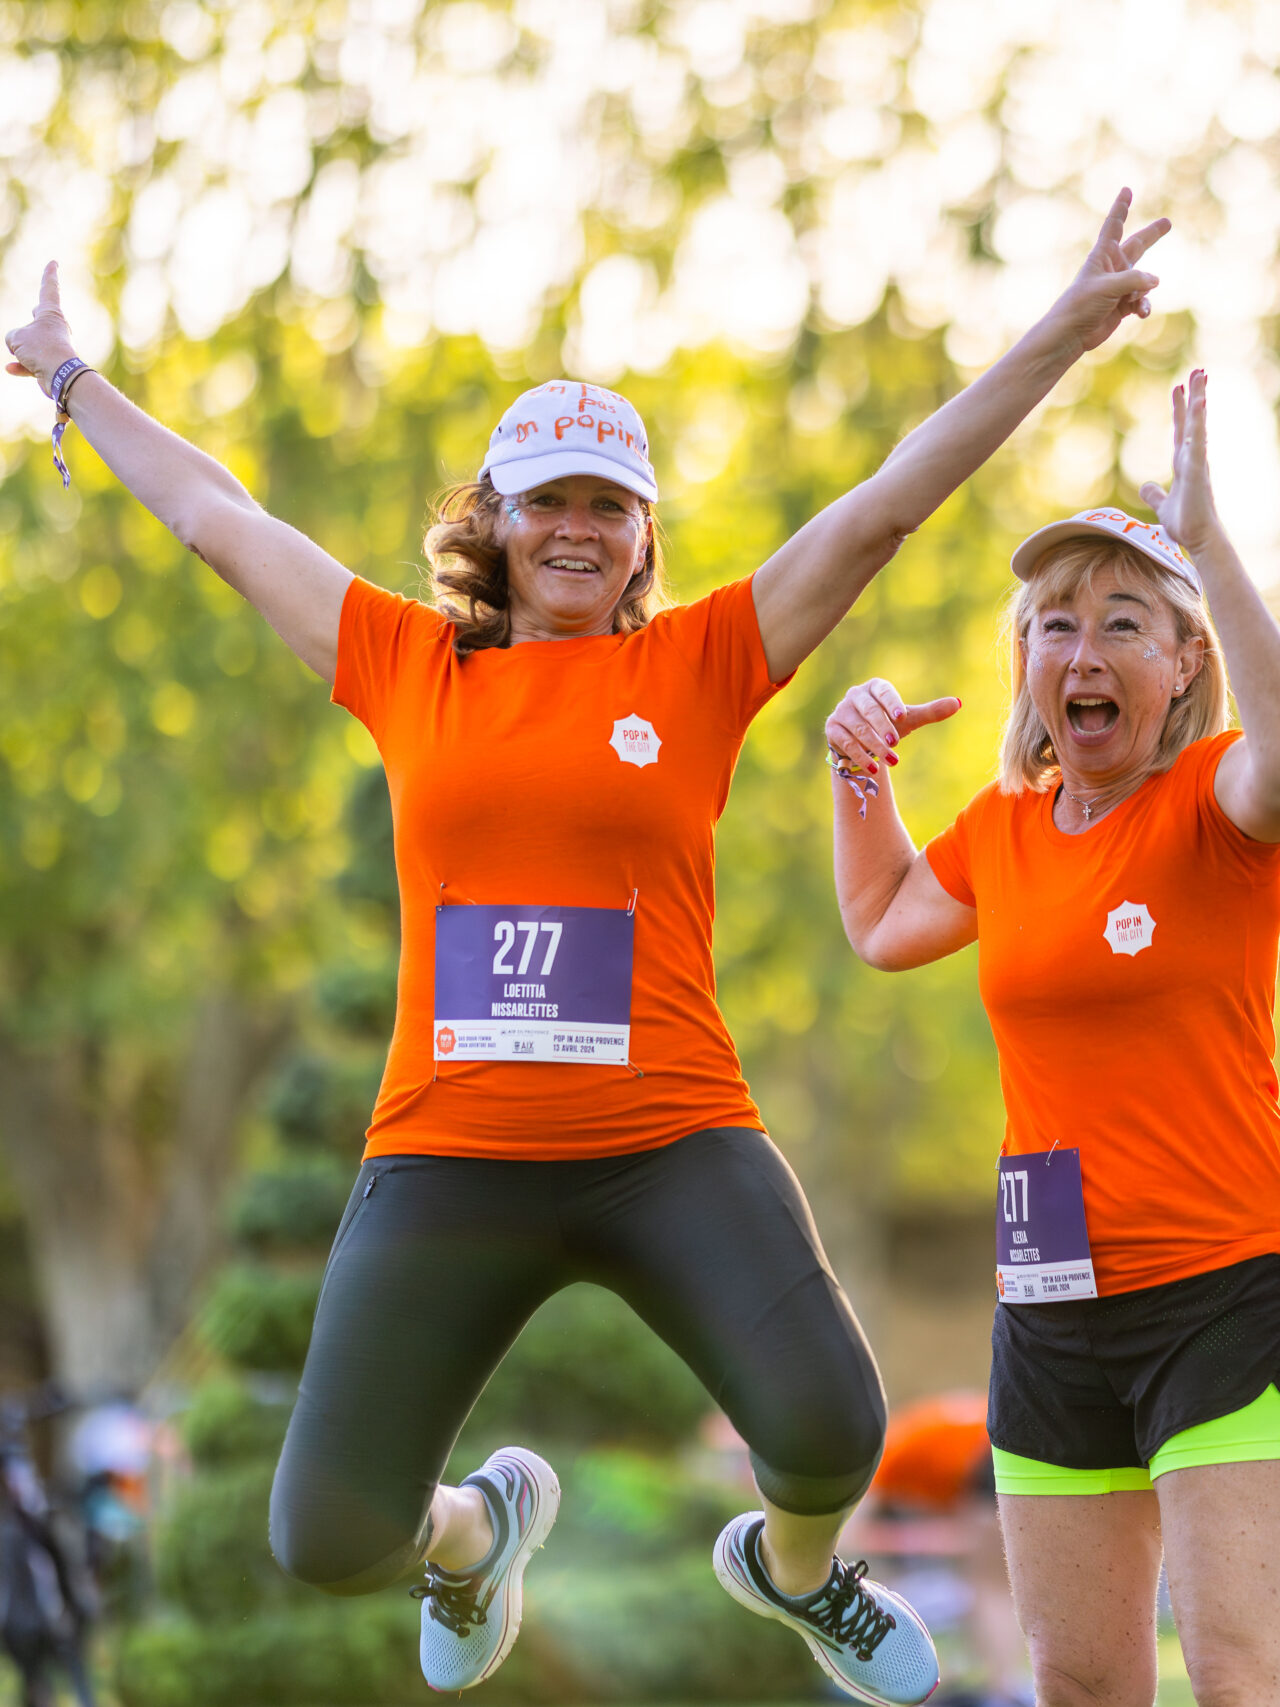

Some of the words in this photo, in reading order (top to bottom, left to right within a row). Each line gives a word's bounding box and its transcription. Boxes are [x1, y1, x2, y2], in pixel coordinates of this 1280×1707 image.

[623, 730, 639, 740] POP
[640, 730, 649, 741] IN
[625, 742, 636, 752] THE
[637, 742, 650, 752] CITY
[1115, 918, 1132, 930] POP
[1133, 915, 1142, 927] IN
[1117, 931, 1128, 943] THE
[1129, 928, 1143, 940] CITY
[492, 920, 563, 976] 277
[504, 983, 546, 999] LOETITIA
[491, 1002, 559, 1018] NISSARLETTES
[553, 1034, 566, 1043] POP
[567, 1035, 574, 1043] IN
[553, 1044, 560, 1052] 13
[561, 1044, 578, 1053] AVRIL
[580, 1045, 595, 1053] 2024
[1001, 1170, 1029, 1223] 277
